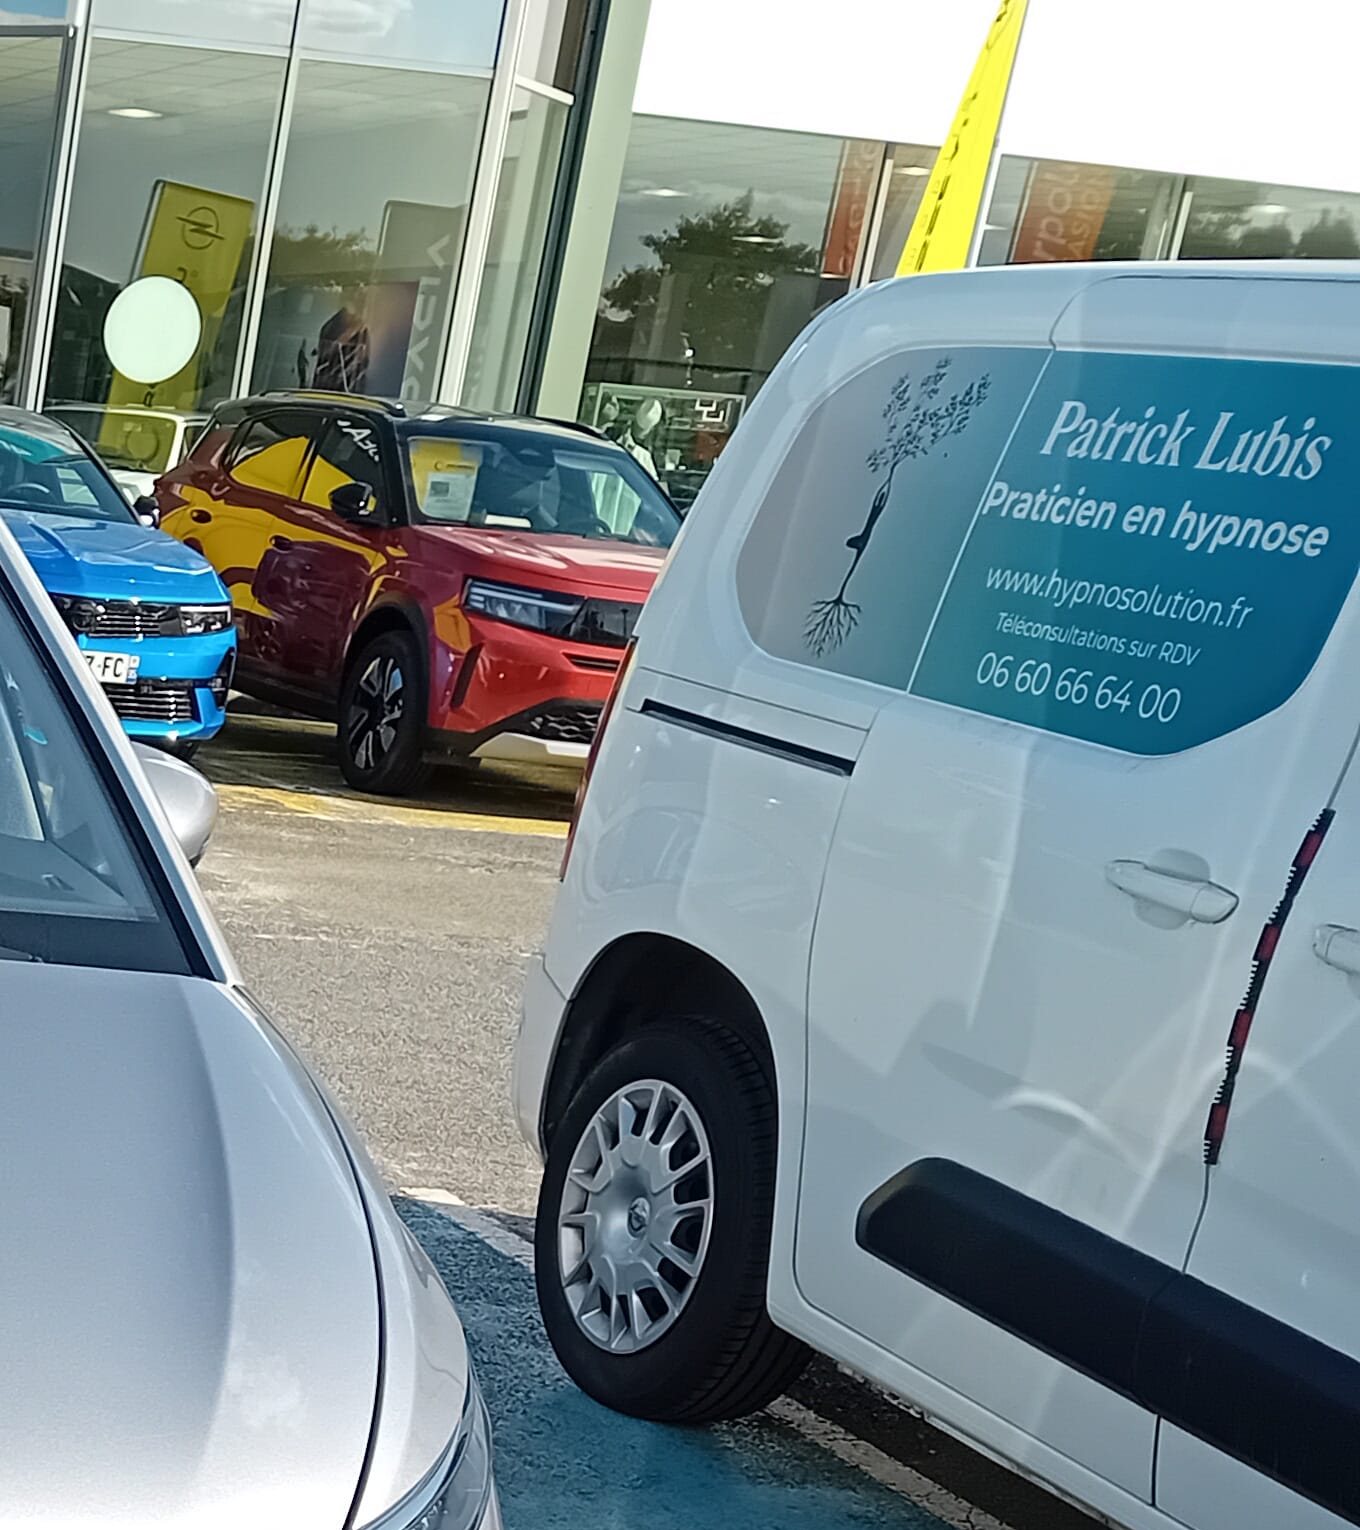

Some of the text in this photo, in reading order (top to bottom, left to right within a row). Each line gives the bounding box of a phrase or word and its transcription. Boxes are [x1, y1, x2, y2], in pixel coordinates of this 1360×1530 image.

[1040, 399, 1332, 481] Patrick Lubis
[982, 481, 1329, 558] Praticien en hypnose
[986, 566, 1253, 631] www.hypnosolution.fr
[996, 611, 1200, 667] Téléconsultations sur RDV
[977, 652, 1181, 724] 06 60 66 64 00
